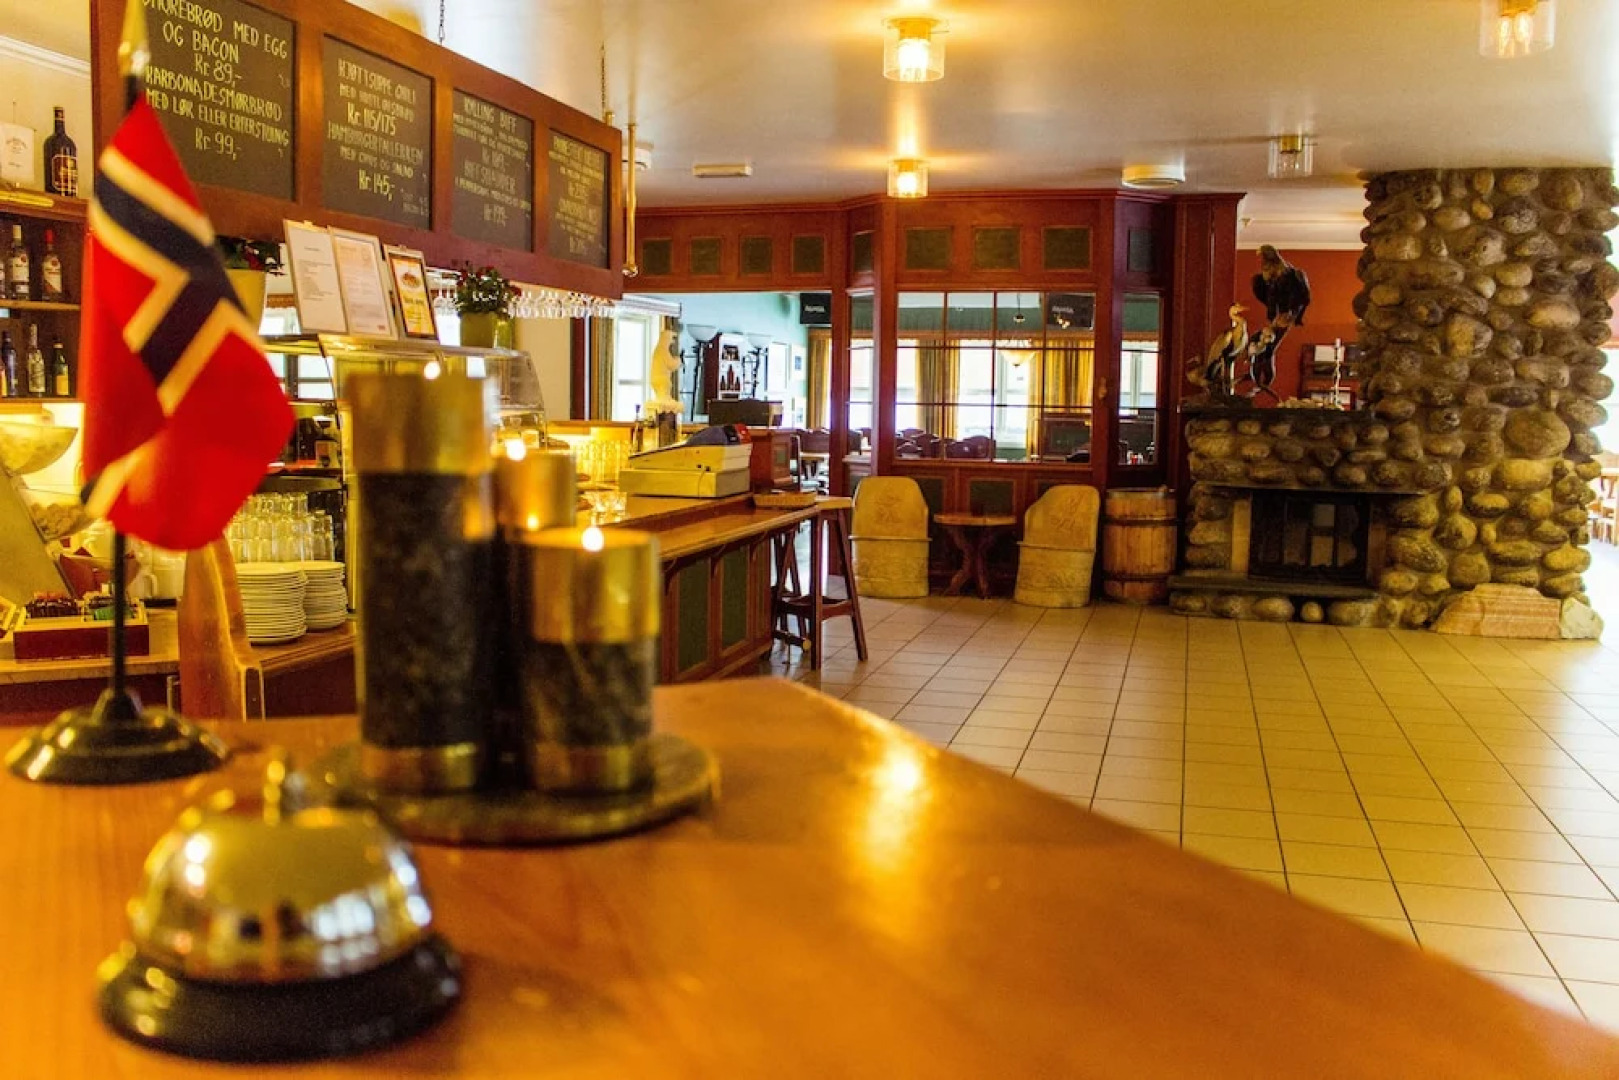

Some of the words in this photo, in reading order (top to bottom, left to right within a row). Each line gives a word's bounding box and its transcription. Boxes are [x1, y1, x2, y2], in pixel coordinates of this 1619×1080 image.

[163, 20, 184, 47] OG
[192, 30, 239, 63] BACON
[233, 20, 259, 47] MED
[264, 33, 287, 59] EGG
[145, 89, 169, 111] MED
[198, 104, 227, 128] ELLER
